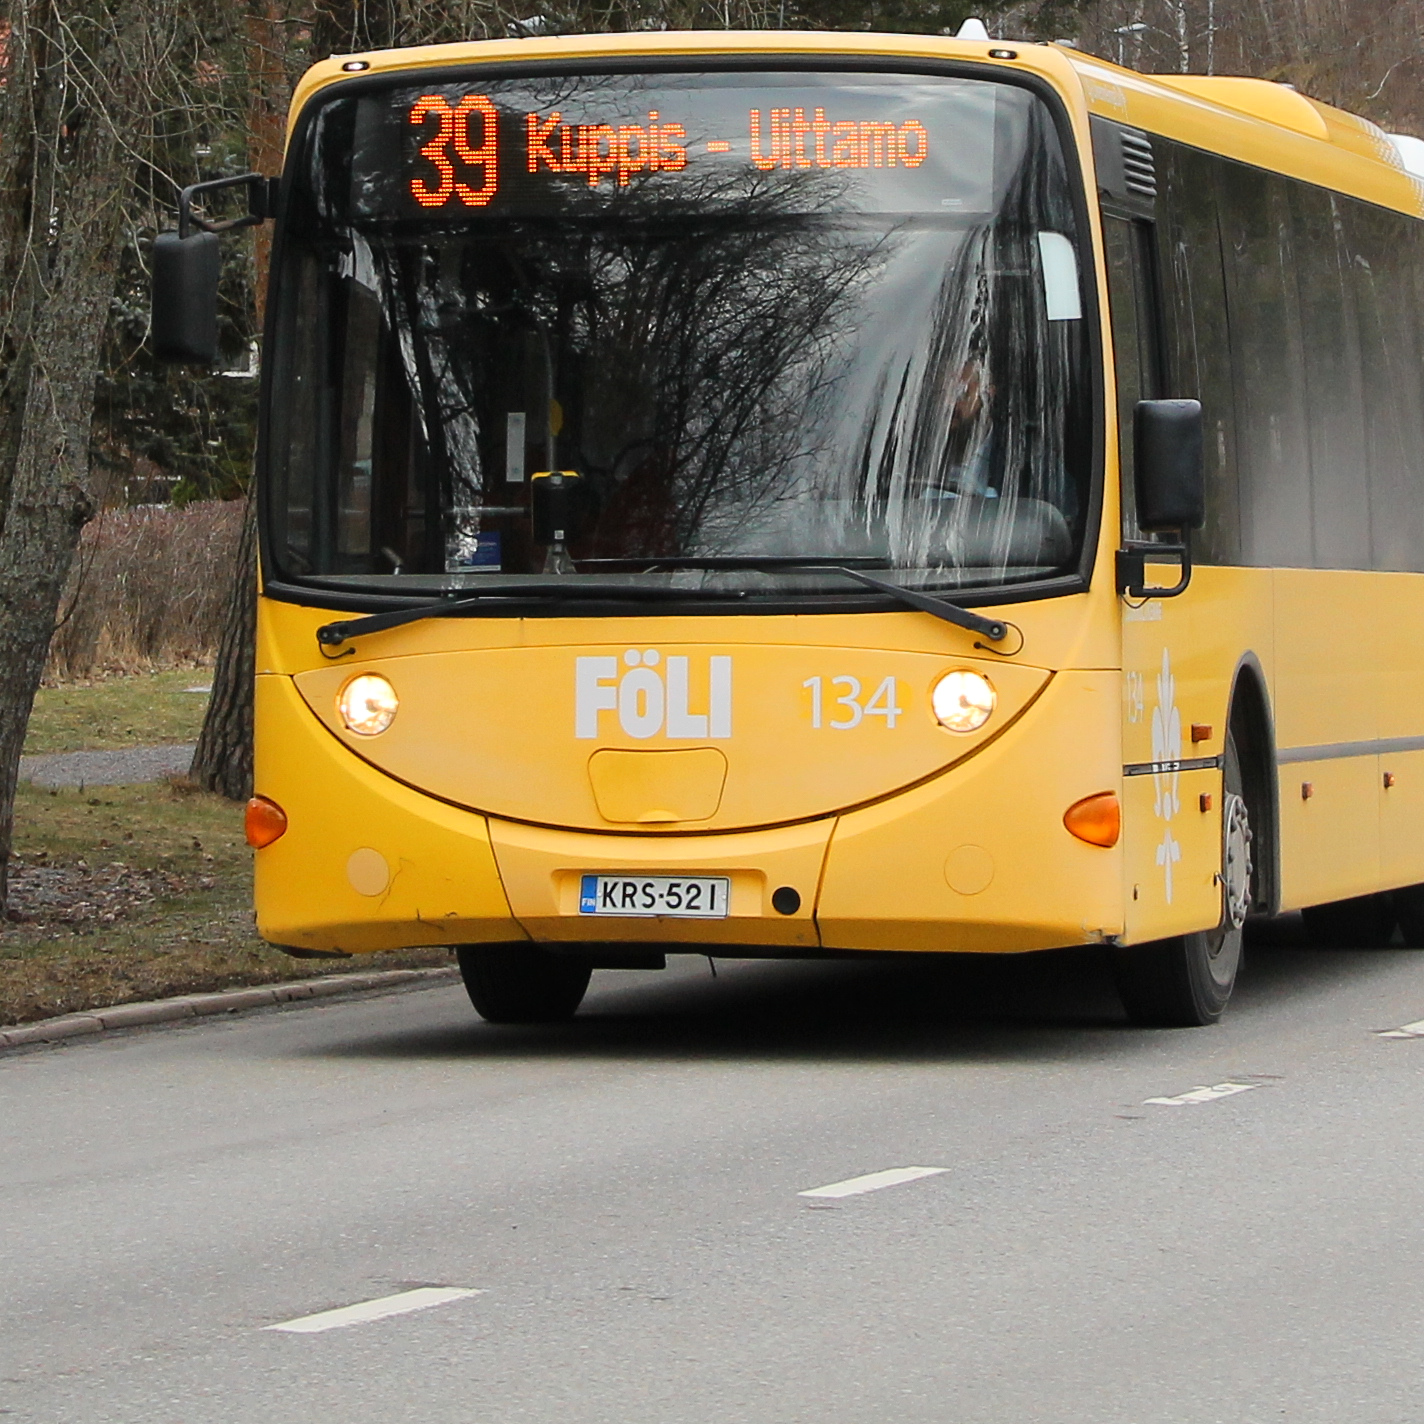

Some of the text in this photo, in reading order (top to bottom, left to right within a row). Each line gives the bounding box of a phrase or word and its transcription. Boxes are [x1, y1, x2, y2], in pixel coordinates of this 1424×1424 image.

[409, 94, 499, 207] 39
[526, 110, 688, 186] Kuppis
[749, 107, 929, 170] Uittamo
[575, 648, 732, 739] FÖLI
[801, 675, 903, 730] 134
[1127, 671, 1144, 723] 134
[602, 881, 716, 911] KRS-521
